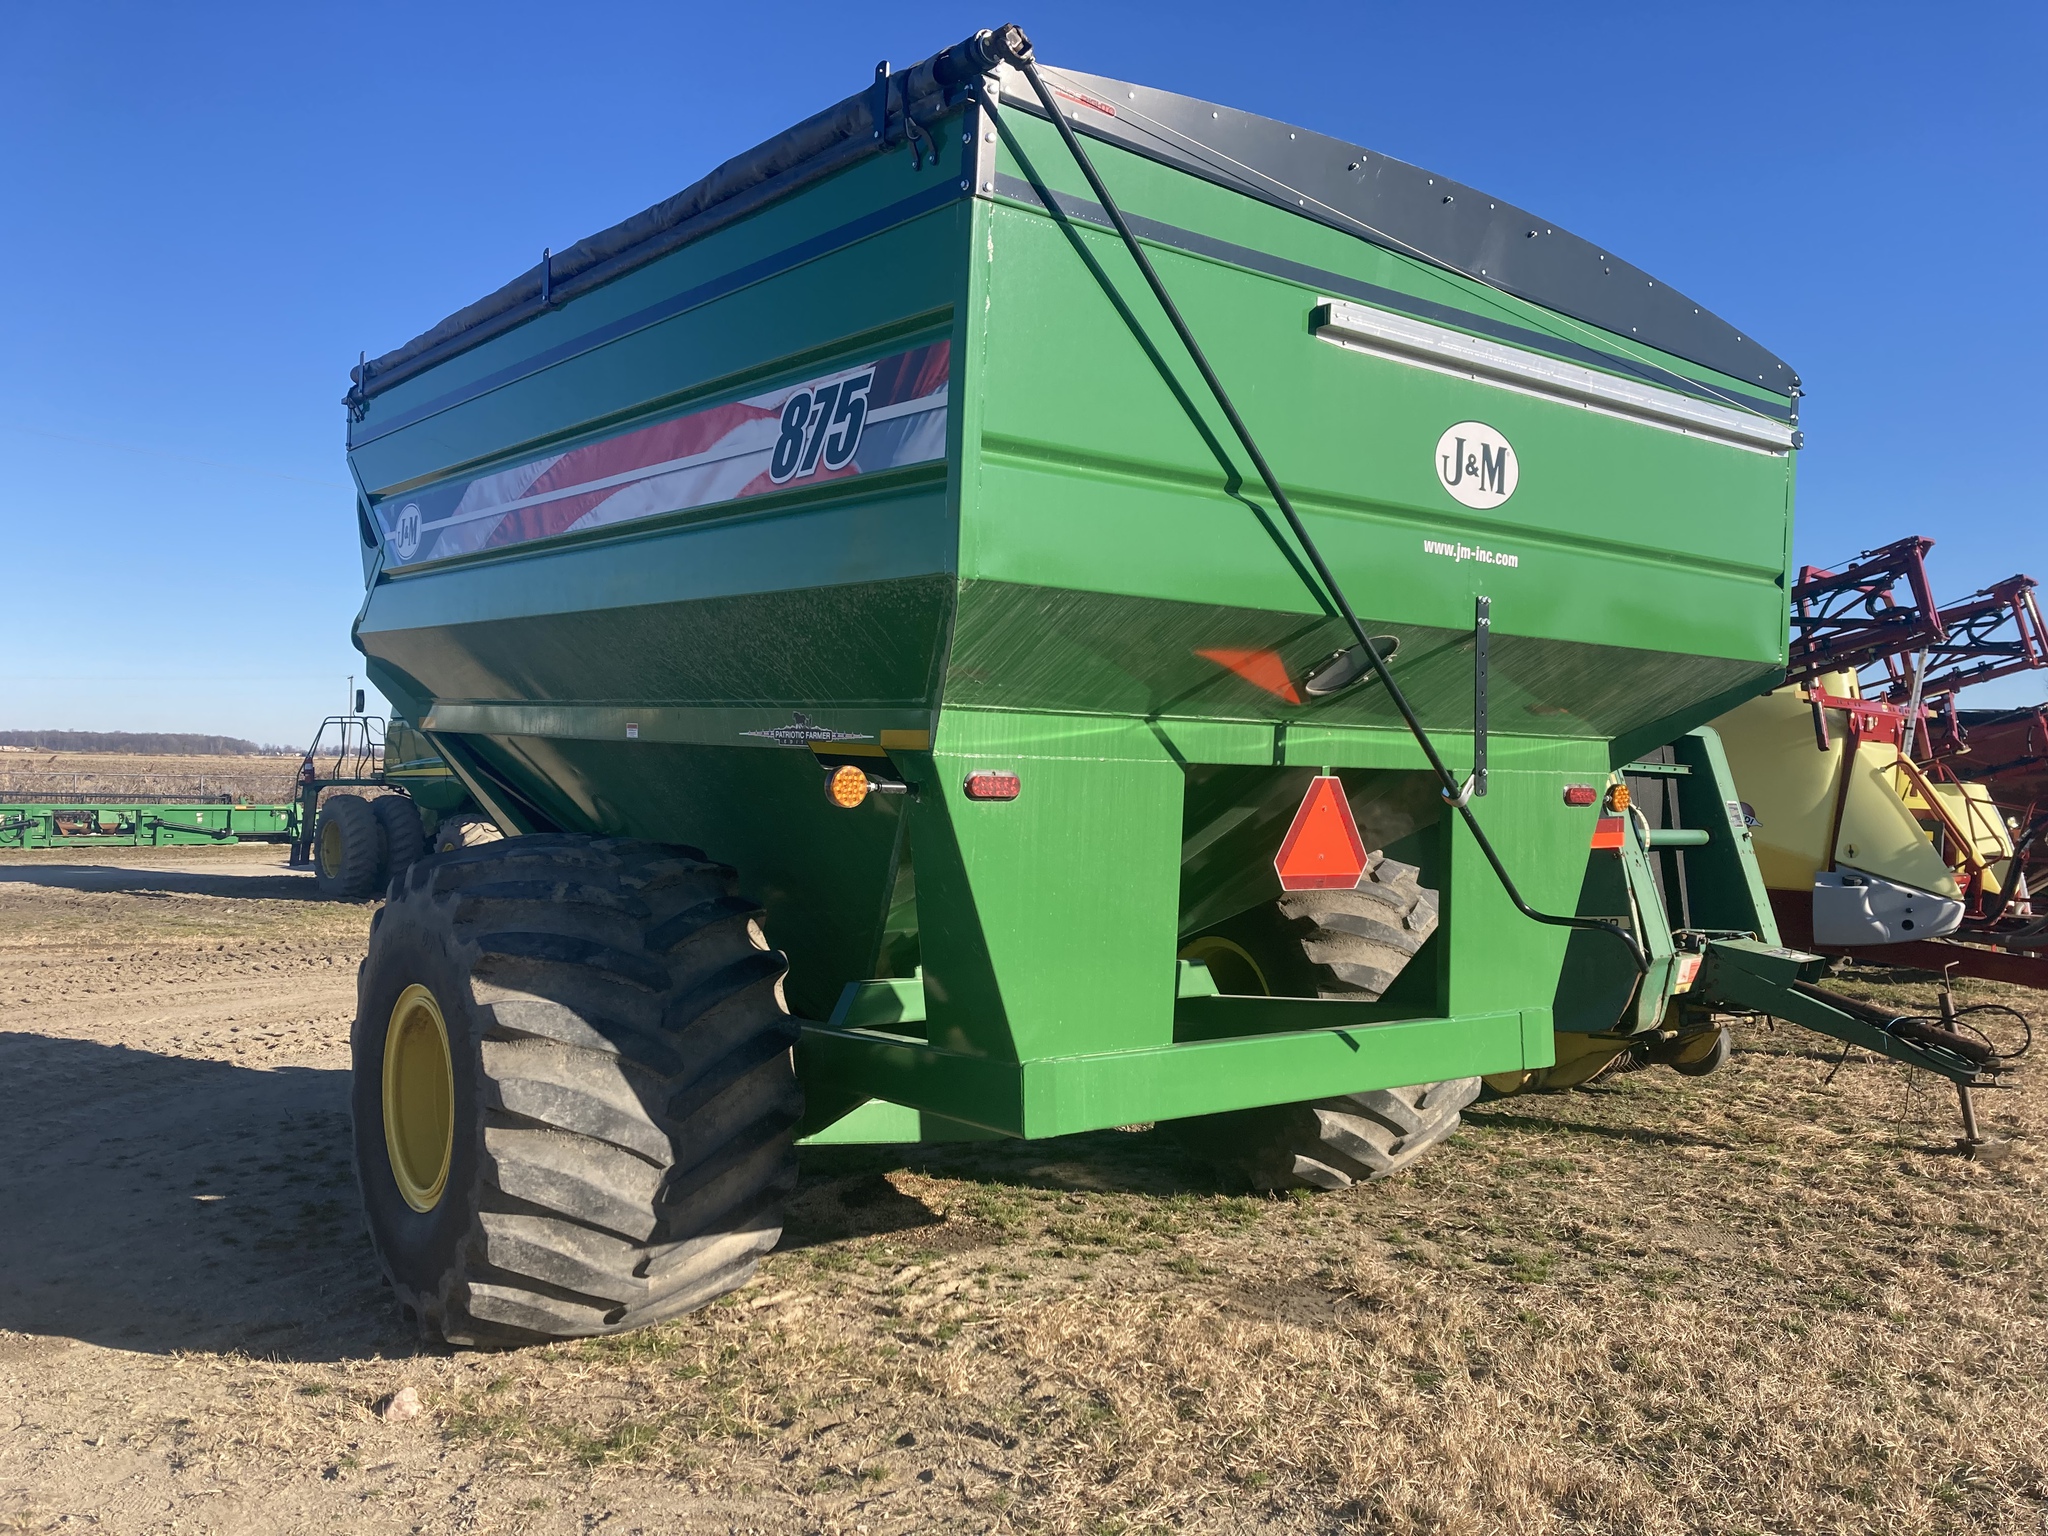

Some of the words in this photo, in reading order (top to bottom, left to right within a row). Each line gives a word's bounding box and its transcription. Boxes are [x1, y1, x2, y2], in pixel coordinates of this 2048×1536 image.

[770, 366, 876, 483] 875
[1442, 436, 1508, 496] J&M
[397, 515, 418, 549] J&M
[1423, 539, 1519, 568] www.jm-inc.com
[775, 730, 804, 739] PATRIOTIC
[805, 731, 831, 740] FARMER
